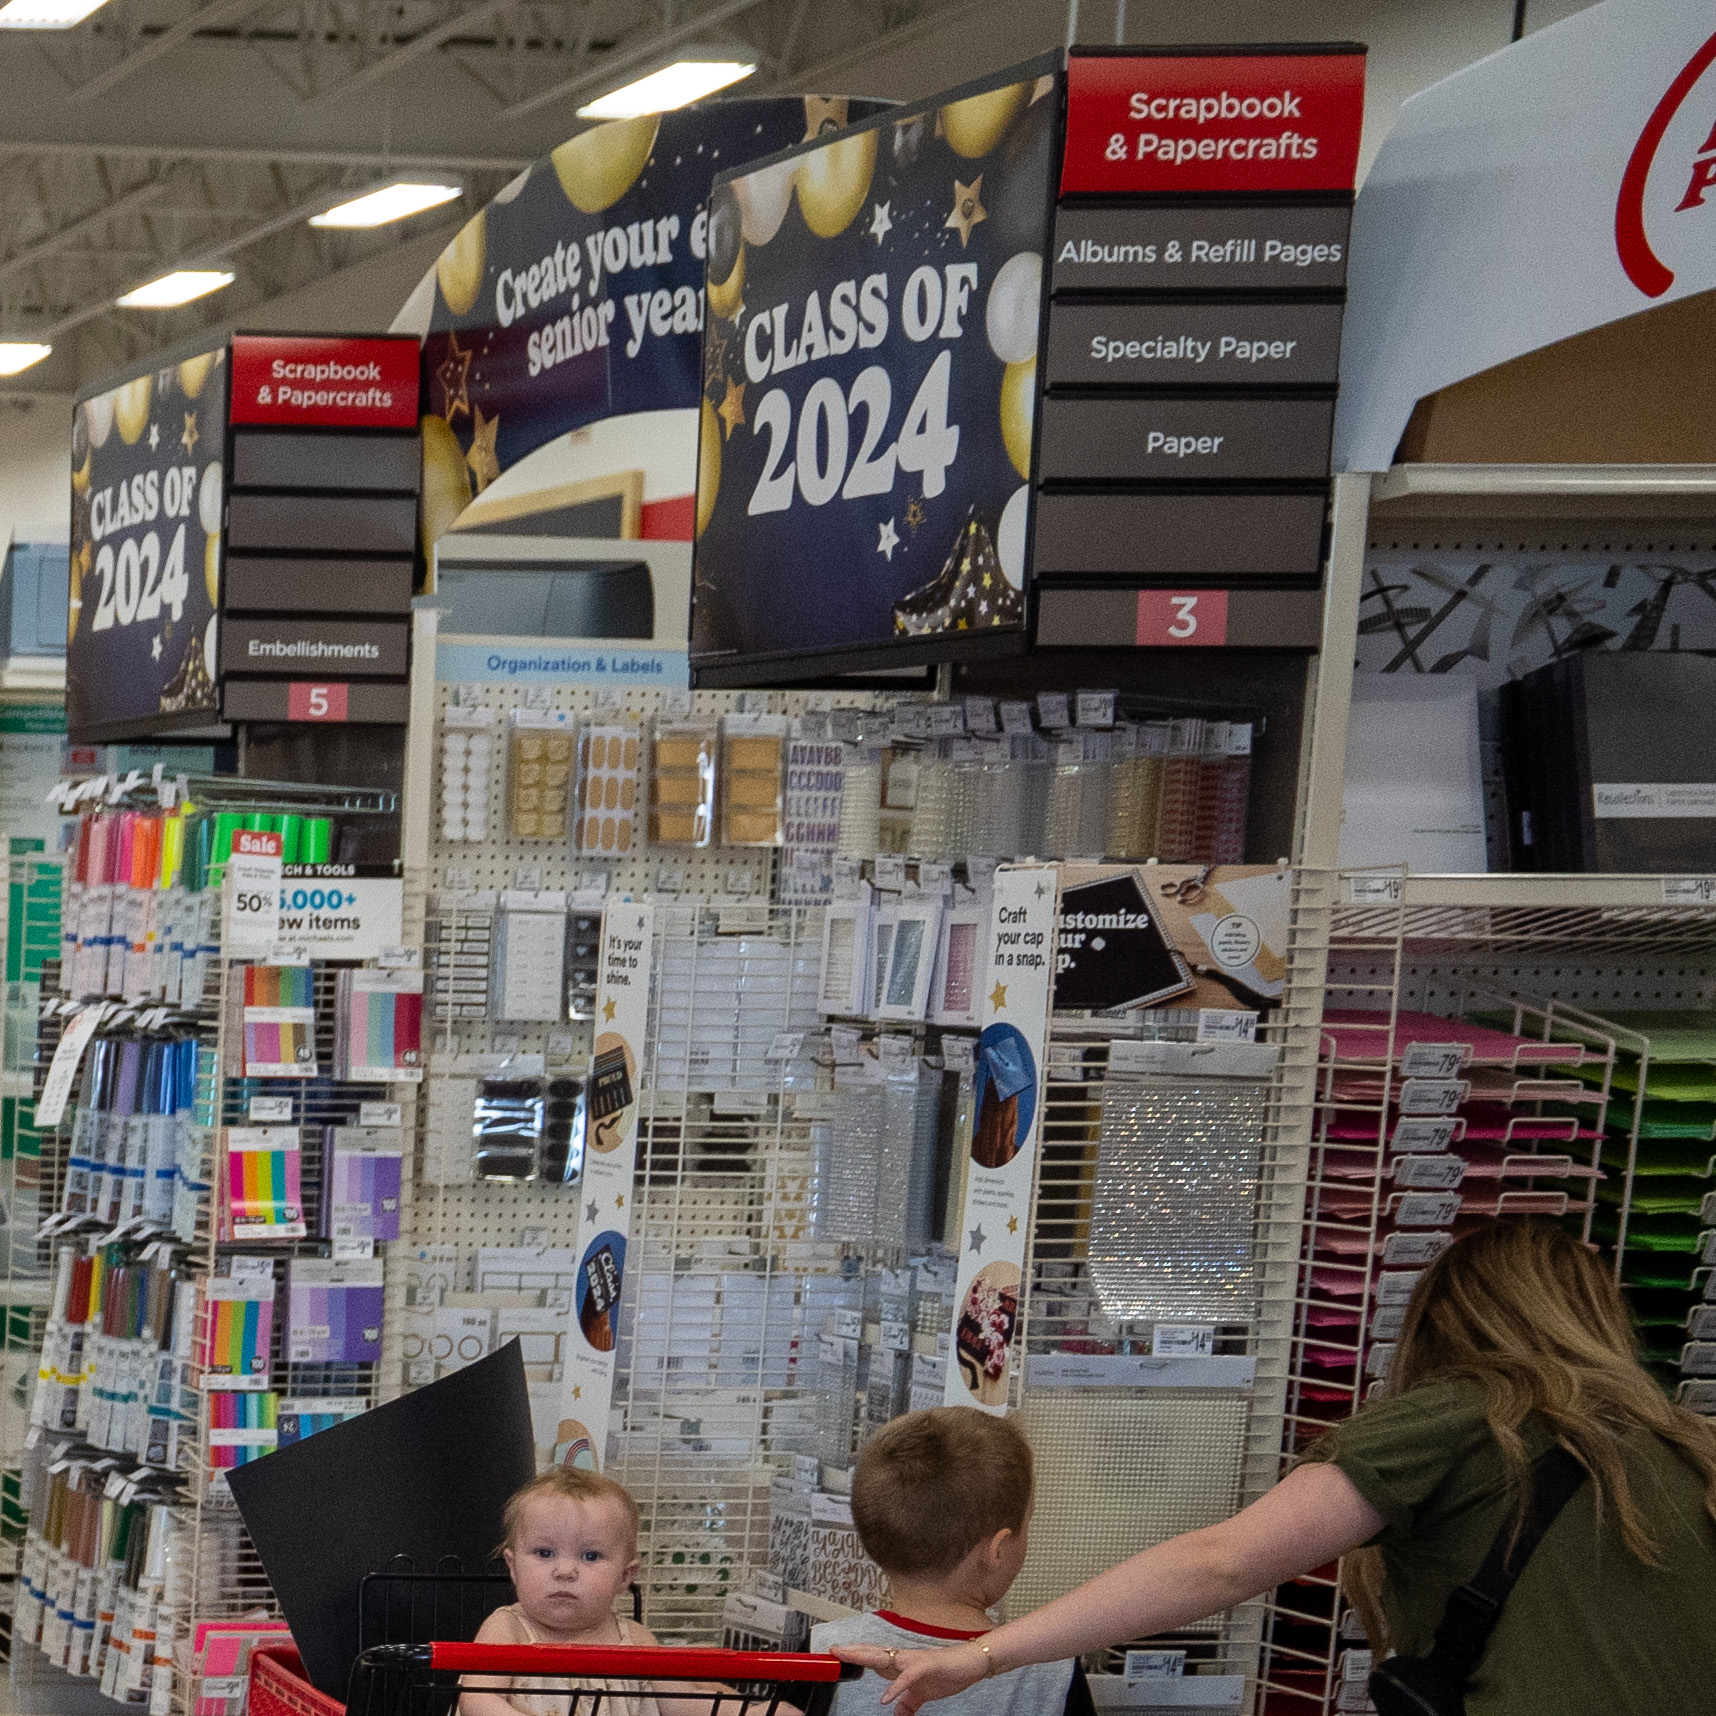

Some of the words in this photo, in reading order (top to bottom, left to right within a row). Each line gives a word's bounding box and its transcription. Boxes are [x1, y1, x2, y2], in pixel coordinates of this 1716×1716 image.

[1129, 92, 1301, 124] Scrapbook
[1105, 135, 1127, 162] &
[1136, 134, 1318, 166] Papercrafts
[1058, 240, 1157, 265] Albums
[1164, 241, 1183, 262] &
[1191, 239, 1256, 263] Refill
[1264, 241, 1342, 269] Pages
[495, 240, 581, 327] Create
[587, 212, 672, 292] your
[745, 275, 890, 384] CLASS
[901, 263, 978, 342] OF
[526, 305, 611, 378] senior
[1090, 335, 1211, 364] Specialty
[1218, 336, 1296, 364] Paper
[271, 359, 381, 385] Scrapbook
[257, 386, 273, 405] &
[278, 385, 392, 411] Papercrafts
[748, 350, 960, 516] 2024
[1146, 431, 1224, 459] Paper
[91, 466, 160, 541] CLASS
[165, 465, 198, 518] OF
[92, 524, 189, 634] 2024
[1168, 596, 1198, 639] 3
[247, 639, 380, 659] Embellishments
[486, 654, 592, 676] Organization
[595, 655, 608, 674] &
[611, 655, 664, 675] Labels
[308, 688, 329, 715] 5
[239, 835, 277, 854] Sale
[281, 864, 304, 875] ECH
[318, 863, 356, 876] TOOLS
[309, 913, 360, 930] items
[999, 906, 1027, 924] Craft
[1059, 908, 1149, 930] ustomize
[623, 939, 643, 954] your
[996, 931, 1022, 950] your
[1023, 931, 1044, 948] cap
[608, 954, 627, 968] time
[629, 955, 638, 968] to
[995, 951, 1005, 966] in
[1007, 954, 1014, 966] a
[1016, 952, 1045, 970] snap.
[606, 971, 631, 986] shine.
